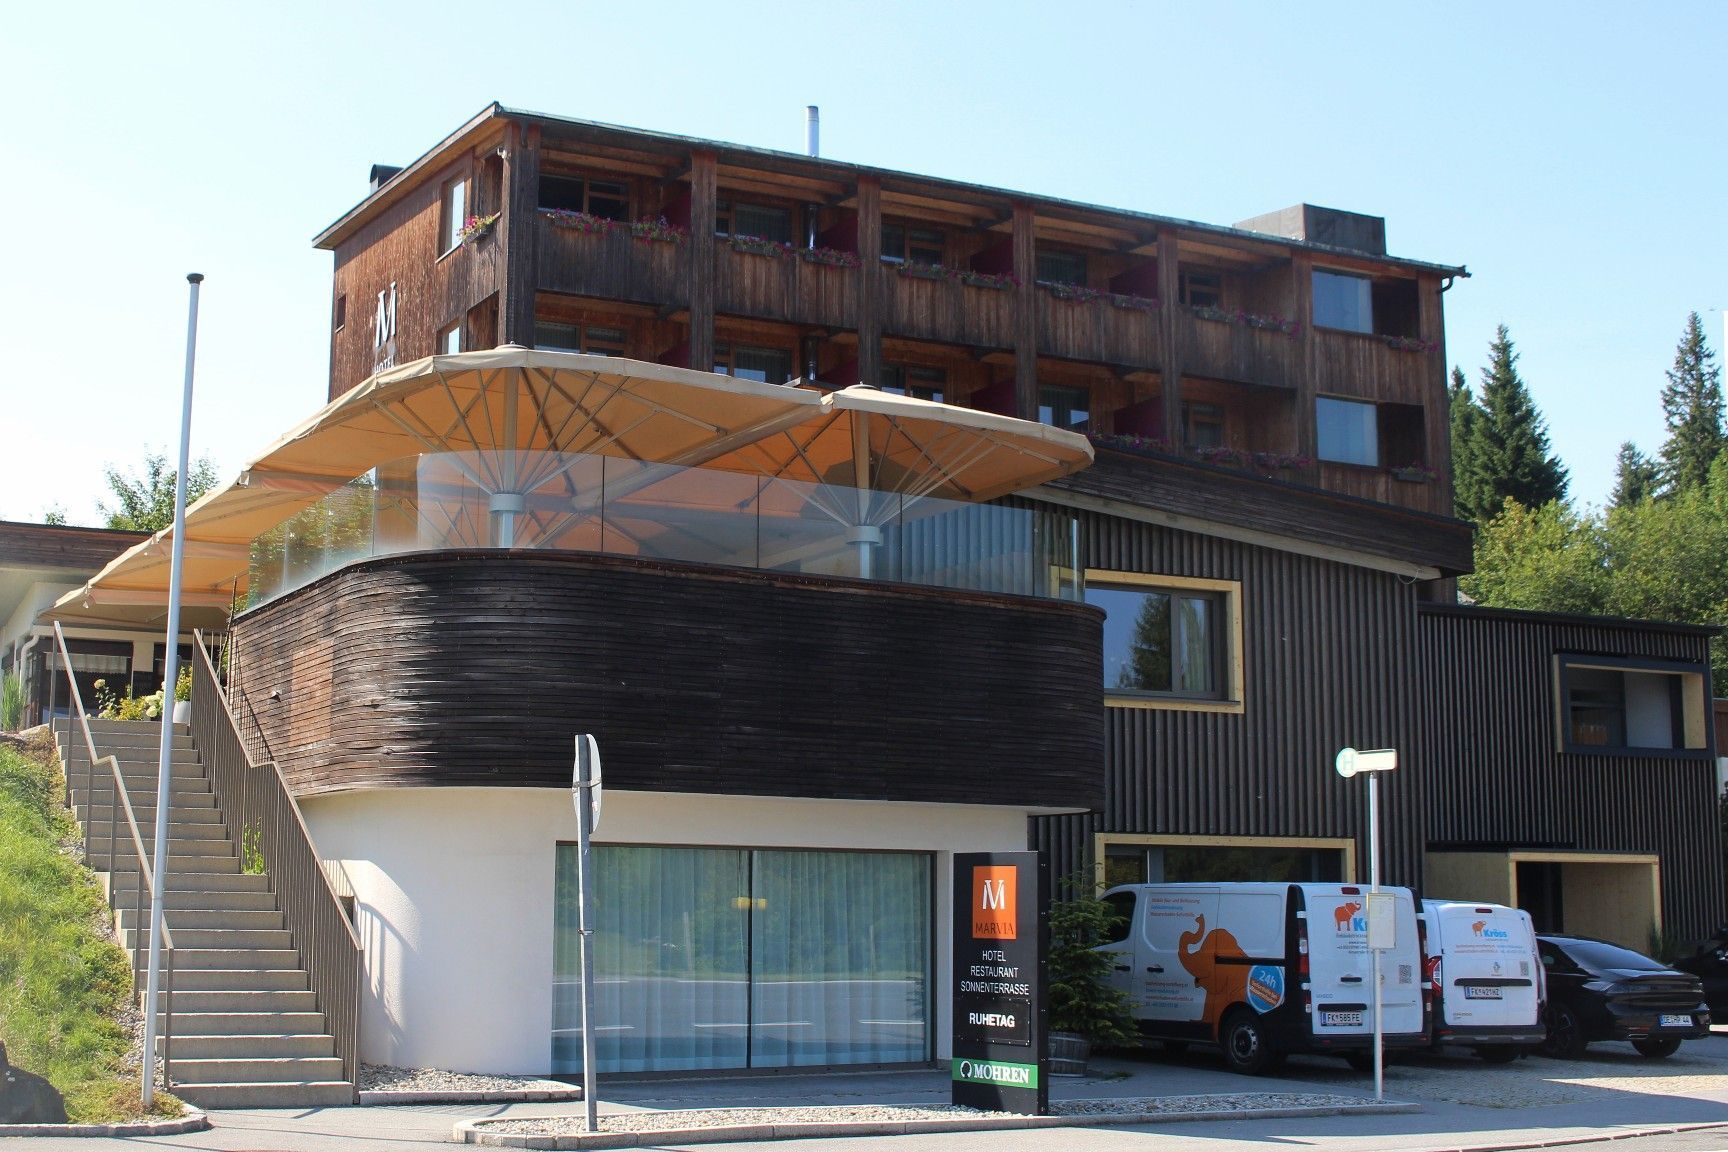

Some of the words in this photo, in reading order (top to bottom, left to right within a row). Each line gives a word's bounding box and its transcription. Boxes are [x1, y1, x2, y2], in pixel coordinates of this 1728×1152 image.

[376, 281, 396, 348] M
[982, 879, 1005, 910] M
[975, 922, 1014, 935] MARVIA
[982, 950, 1006, 962] HOTEL
[970, 965, 1019, 978] RESTAURANT
[1259, 970, 1277, 988] 24h
[960, 981, 1030, 995] SONNENTERRASSE
[969, 1012, 1016, 1028] RUHETAG
[974, 1064, 1030, 1084] MOHREN
